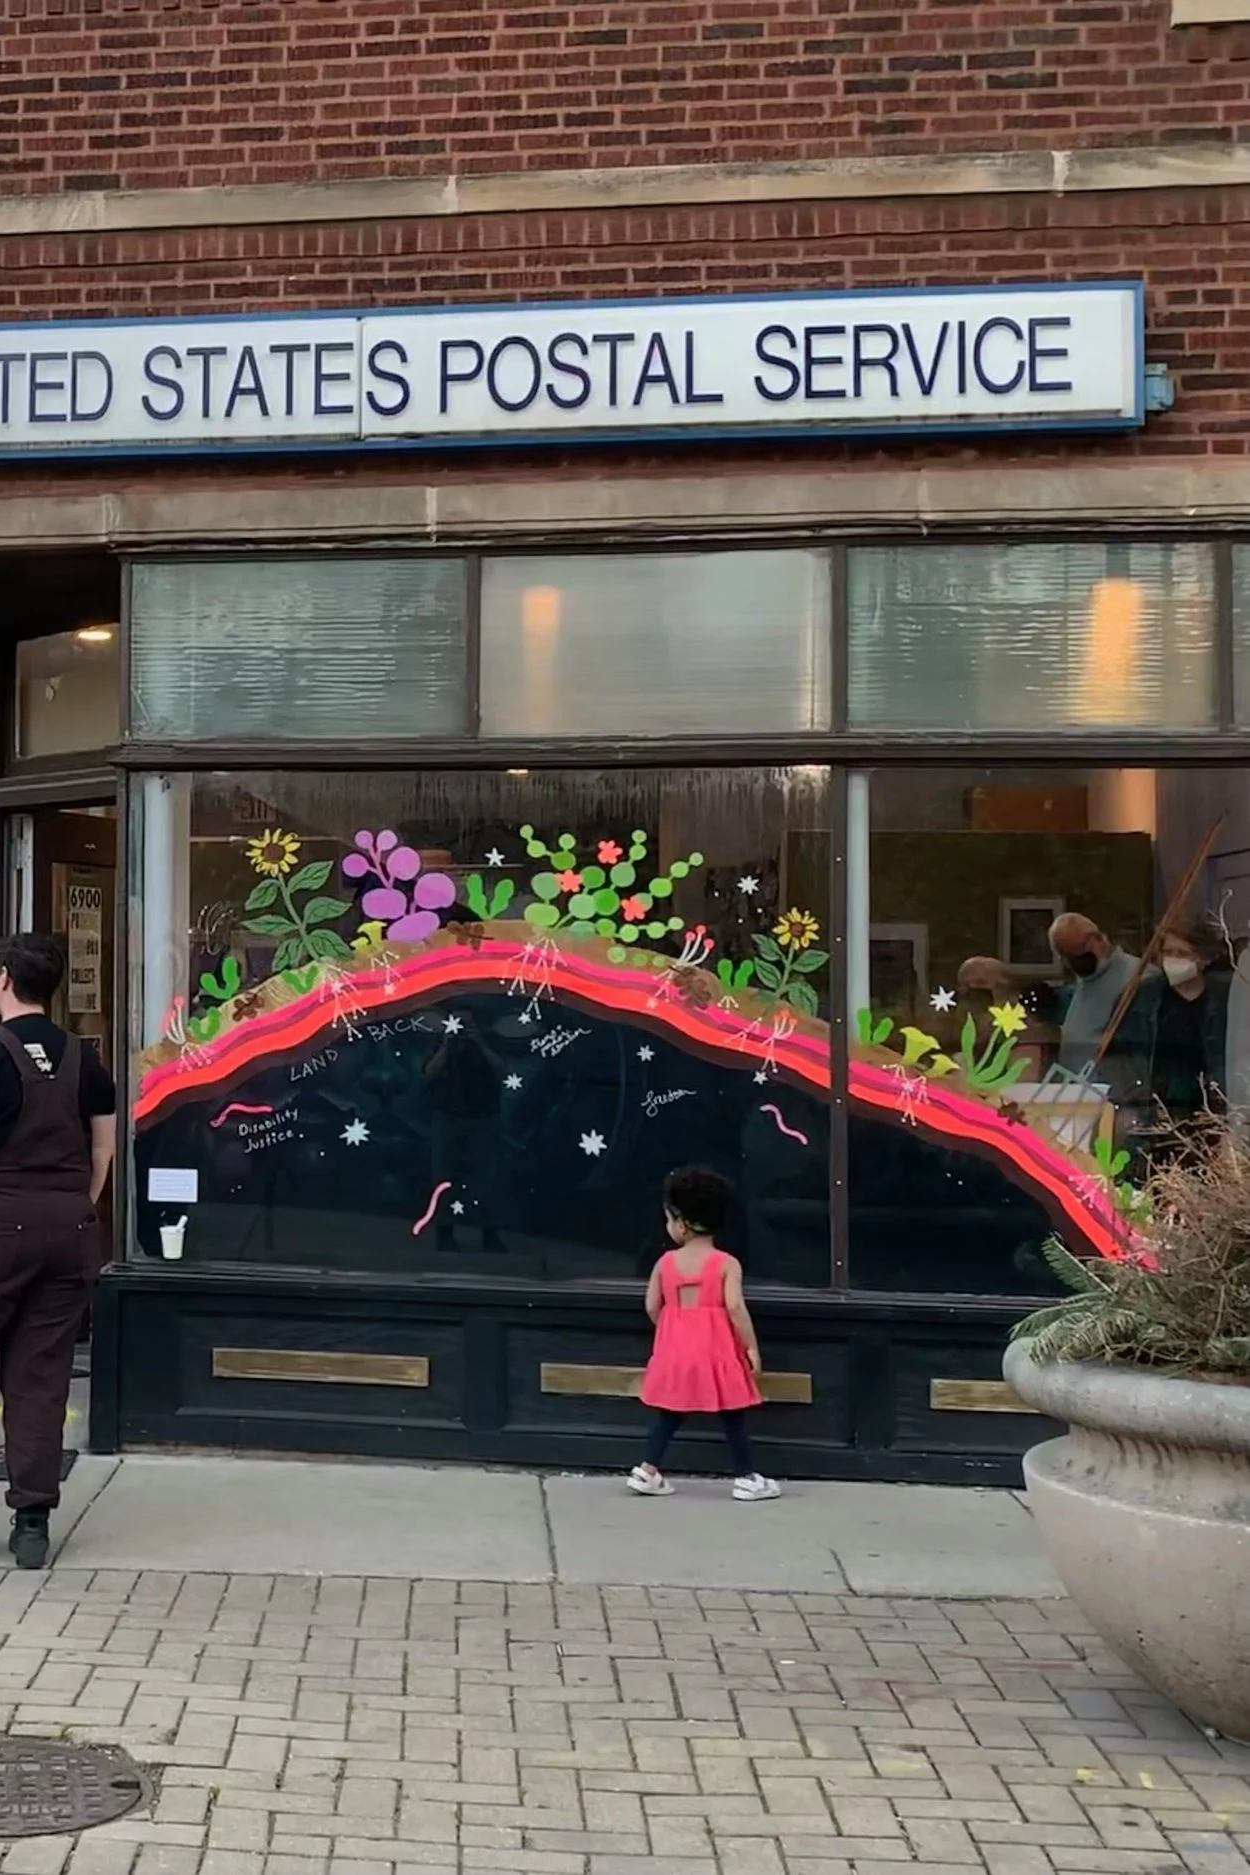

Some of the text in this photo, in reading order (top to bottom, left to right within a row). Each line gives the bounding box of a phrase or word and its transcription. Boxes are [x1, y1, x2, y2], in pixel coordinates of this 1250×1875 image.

[140, 338, 410, 422] STATES
[438, 330, 724, 414] POSTAL
[753, 315, 1073, 402] SERVICE
[69, 887, 101, 909] 6900
[290, 1014, 434, 1082] LAND BACK
[238, 1107, 299, 1137] Disability
